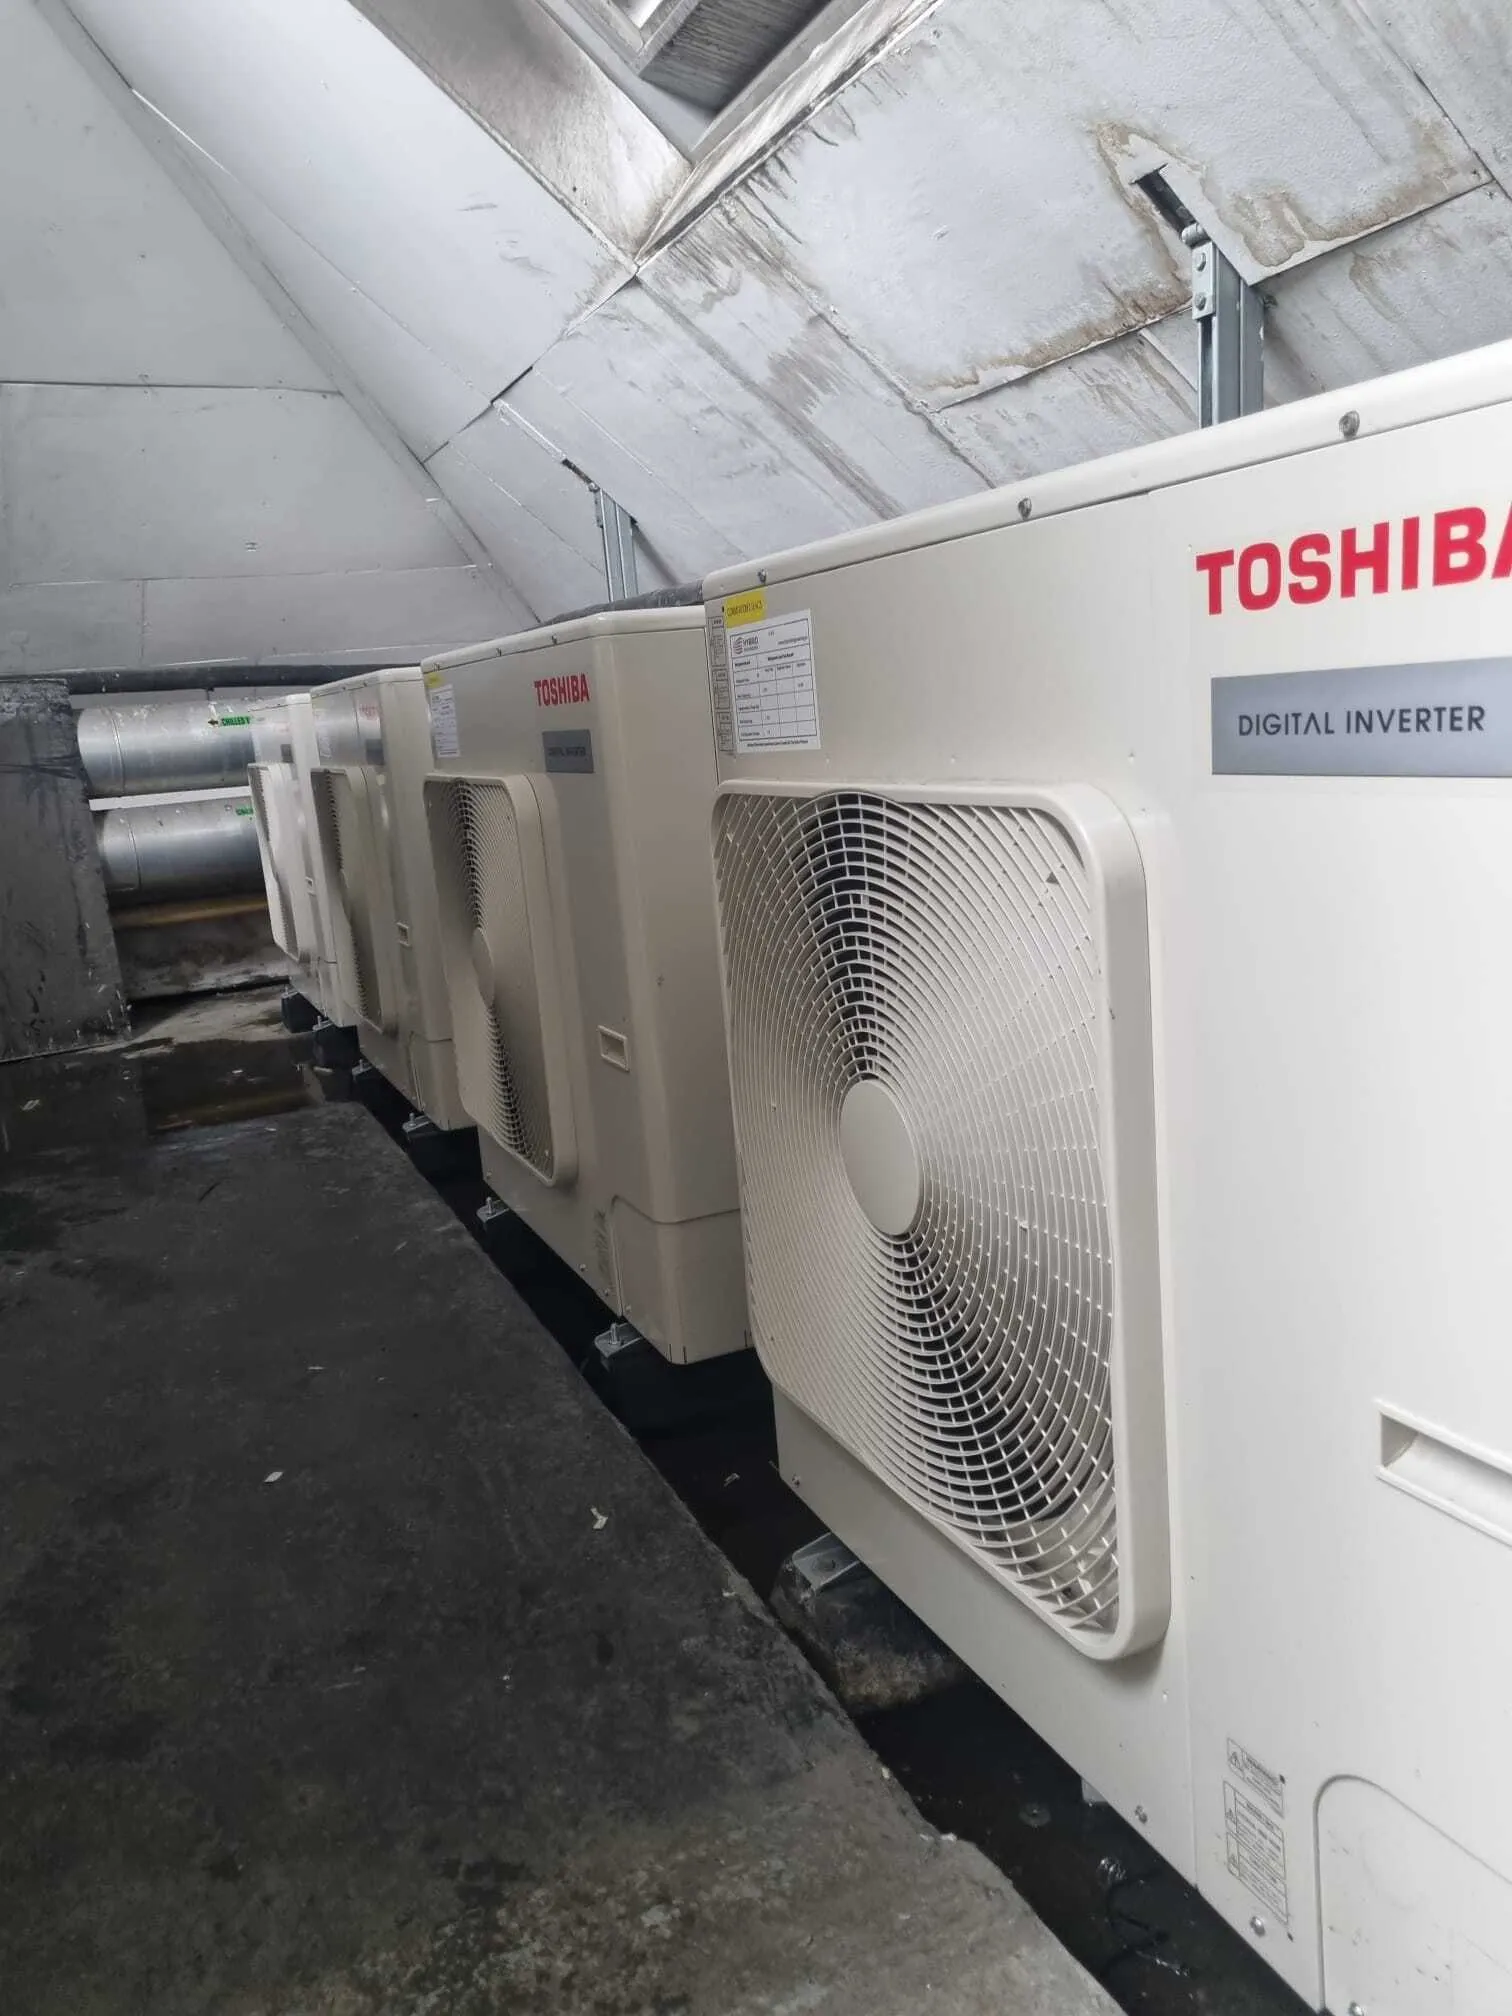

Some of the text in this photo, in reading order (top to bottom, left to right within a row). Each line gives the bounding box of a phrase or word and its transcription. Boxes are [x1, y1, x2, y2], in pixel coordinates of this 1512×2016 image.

[534, 673, 591, 706] TOSHIBA
[1238, 705, 1486, 737] DIGITAL INVERTER
